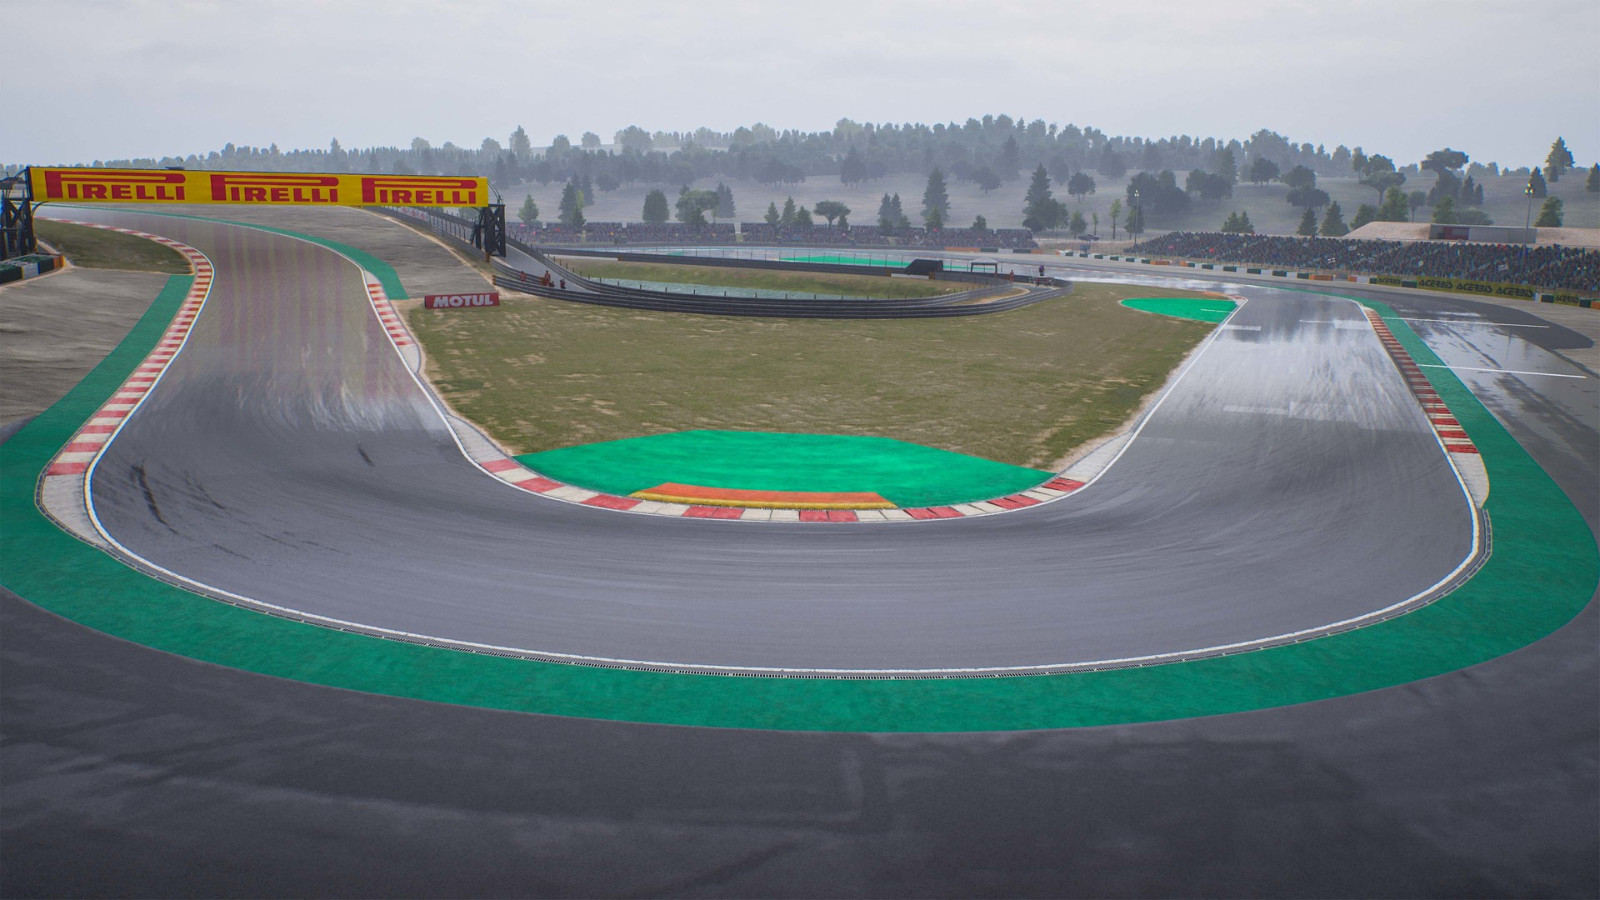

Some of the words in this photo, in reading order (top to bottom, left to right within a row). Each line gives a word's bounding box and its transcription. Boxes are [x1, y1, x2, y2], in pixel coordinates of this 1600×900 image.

[45, 171, 186, 200] PIRELLI
[210, 174, 339, 202] PIRELLI
[361, 177, 478, 204] PIRELLI
[1418, 279, 1453, 289] ACERBIS
[1455, 283, 1493, 294] ACERBIS
[1495, 286, 1534, 297] ACERBIS
[433, 294, 493, 308] MOTUL
